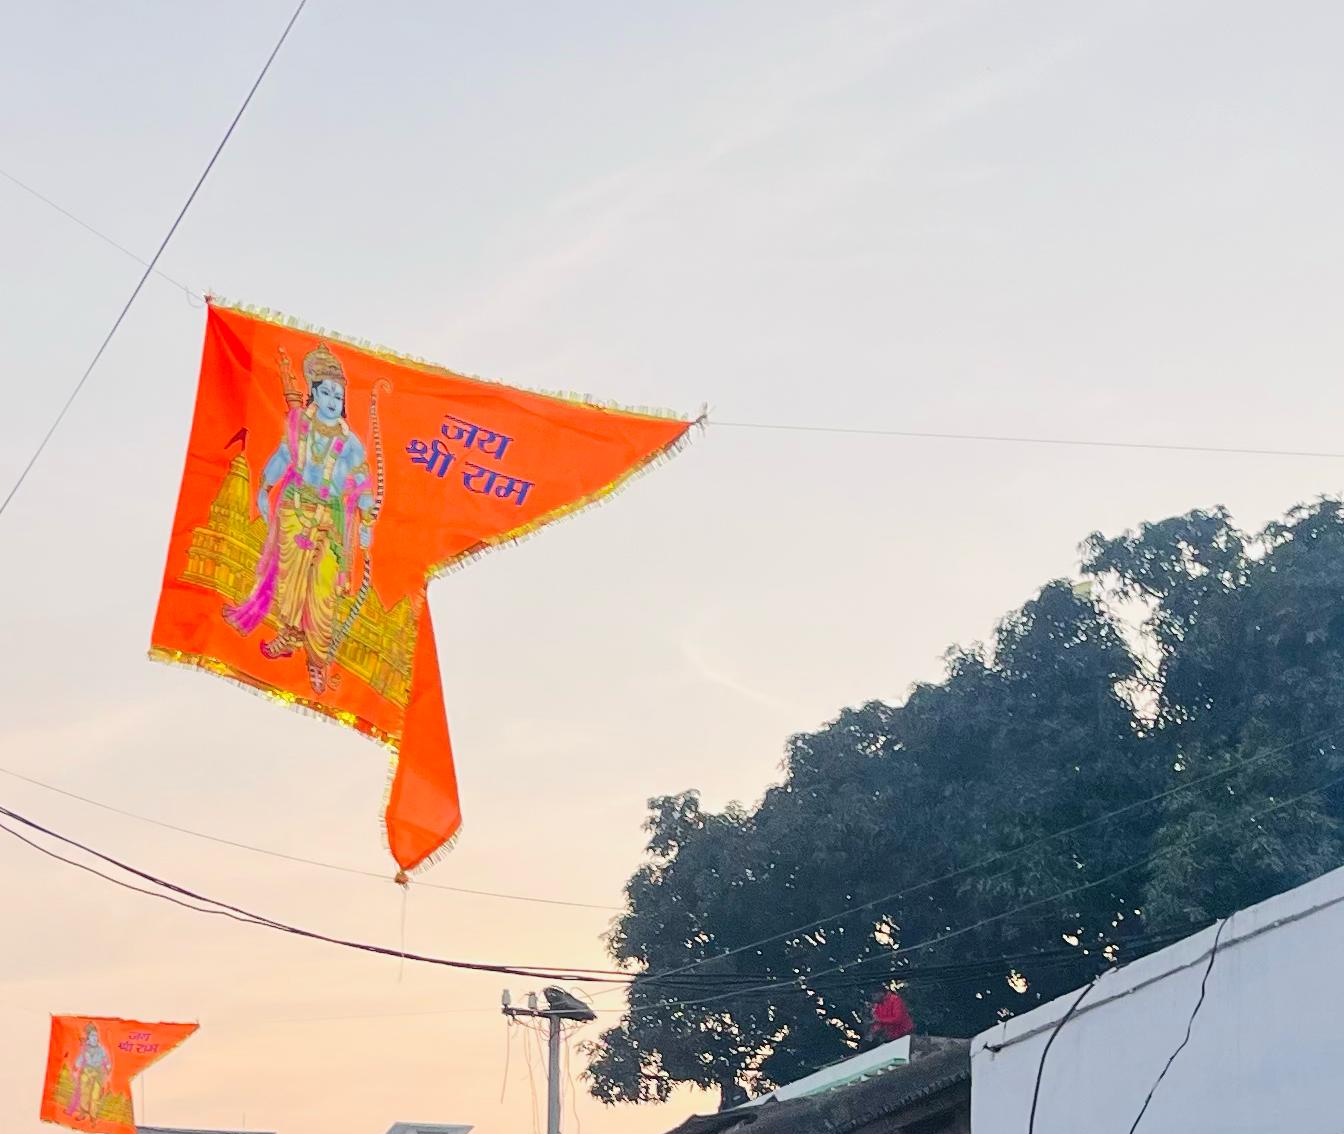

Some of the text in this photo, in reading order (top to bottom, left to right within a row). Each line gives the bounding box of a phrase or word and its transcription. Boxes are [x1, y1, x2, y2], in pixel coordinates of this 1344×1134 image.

[441, 414, 514, 460] जय
[405, 439, 536, 506] श्री राम
